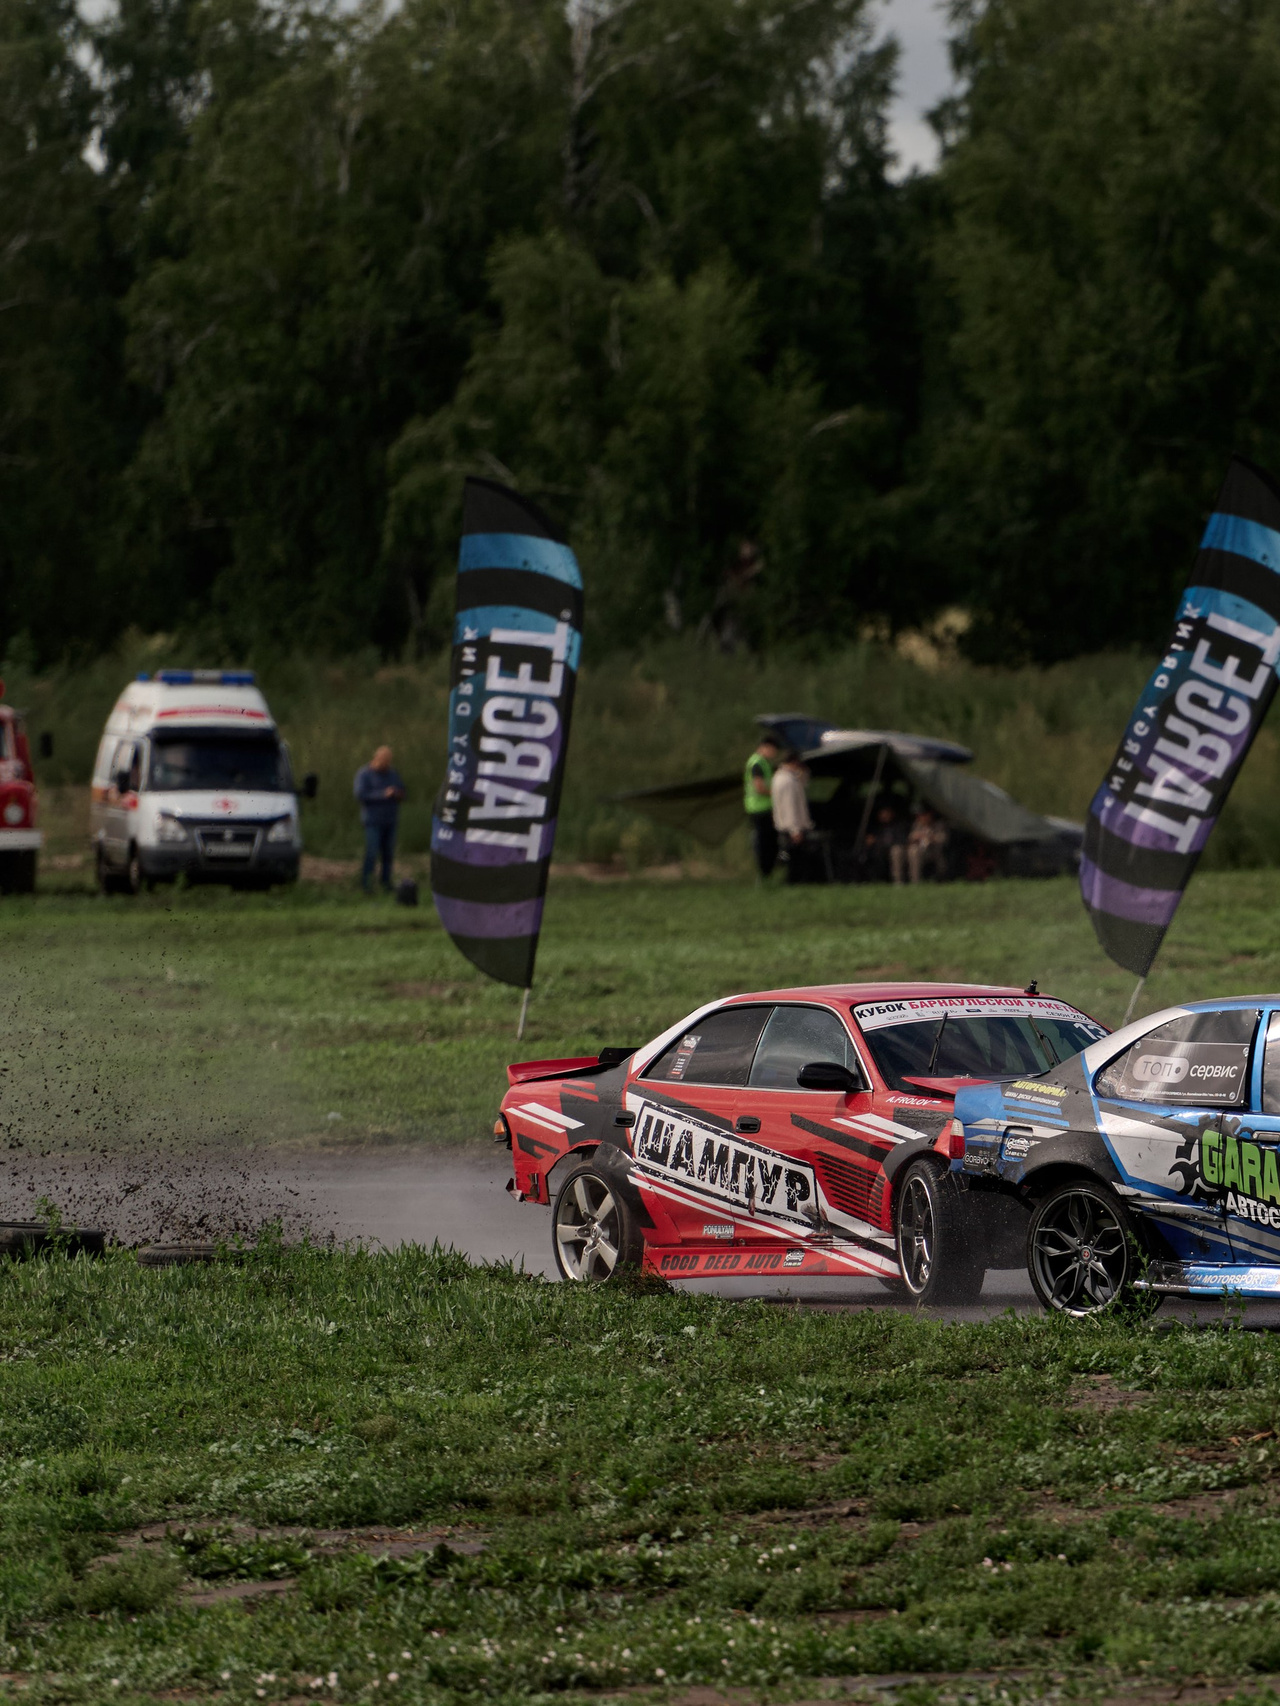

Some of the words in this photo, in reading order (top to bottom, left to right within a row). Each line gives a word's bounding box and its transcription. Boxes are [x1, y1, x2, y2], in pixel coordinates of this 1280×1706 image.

[855, 1002, 907, 1020] КУБОК
[908, 997, 1025, 1010] БАРНАУЛЬСКОЙ
[1073, 1022, 1107, 1041] 13
[1143, 1060, 1174, 1077] ТОП
[1189, 1064, 1238, 1080] сервис
[885, 1095, 933, 1106] A.FROLOV
[637, 1114, 811, 1213] ШАМПУР
[661, 1254, 700, 1271] GOOD
[703, 1254, 743, 1271] DEED
[744, 1254, 783, 1270] AUTO
[1202, 1274, 1266, 1285] MOTORSPORT
